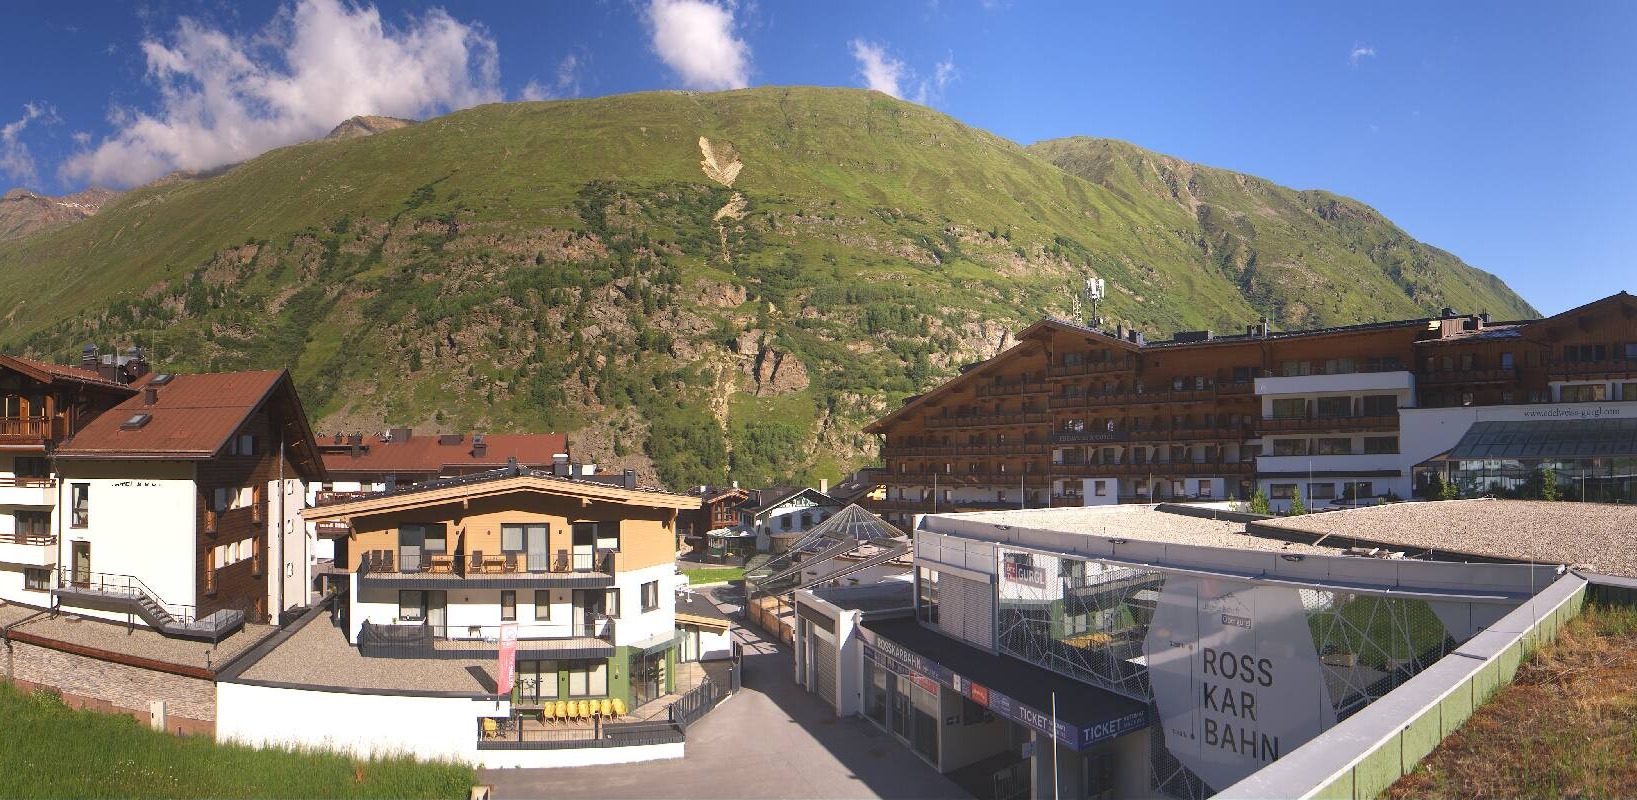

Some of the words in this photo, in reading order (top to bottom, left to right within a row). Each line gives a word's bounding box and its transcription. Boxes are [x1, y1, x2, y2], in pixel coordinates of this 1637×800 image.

[1018, 568, 1045, 585] GURGL
[1203, 647, 1273, 687] ROSS
[1204, 682, 1257, 721] KAR
[1019, 706, 1048, 730] TICKET
[1083, 717, 1122, 742] TICKET
[1204, 717, 1279, 762] BAHN
